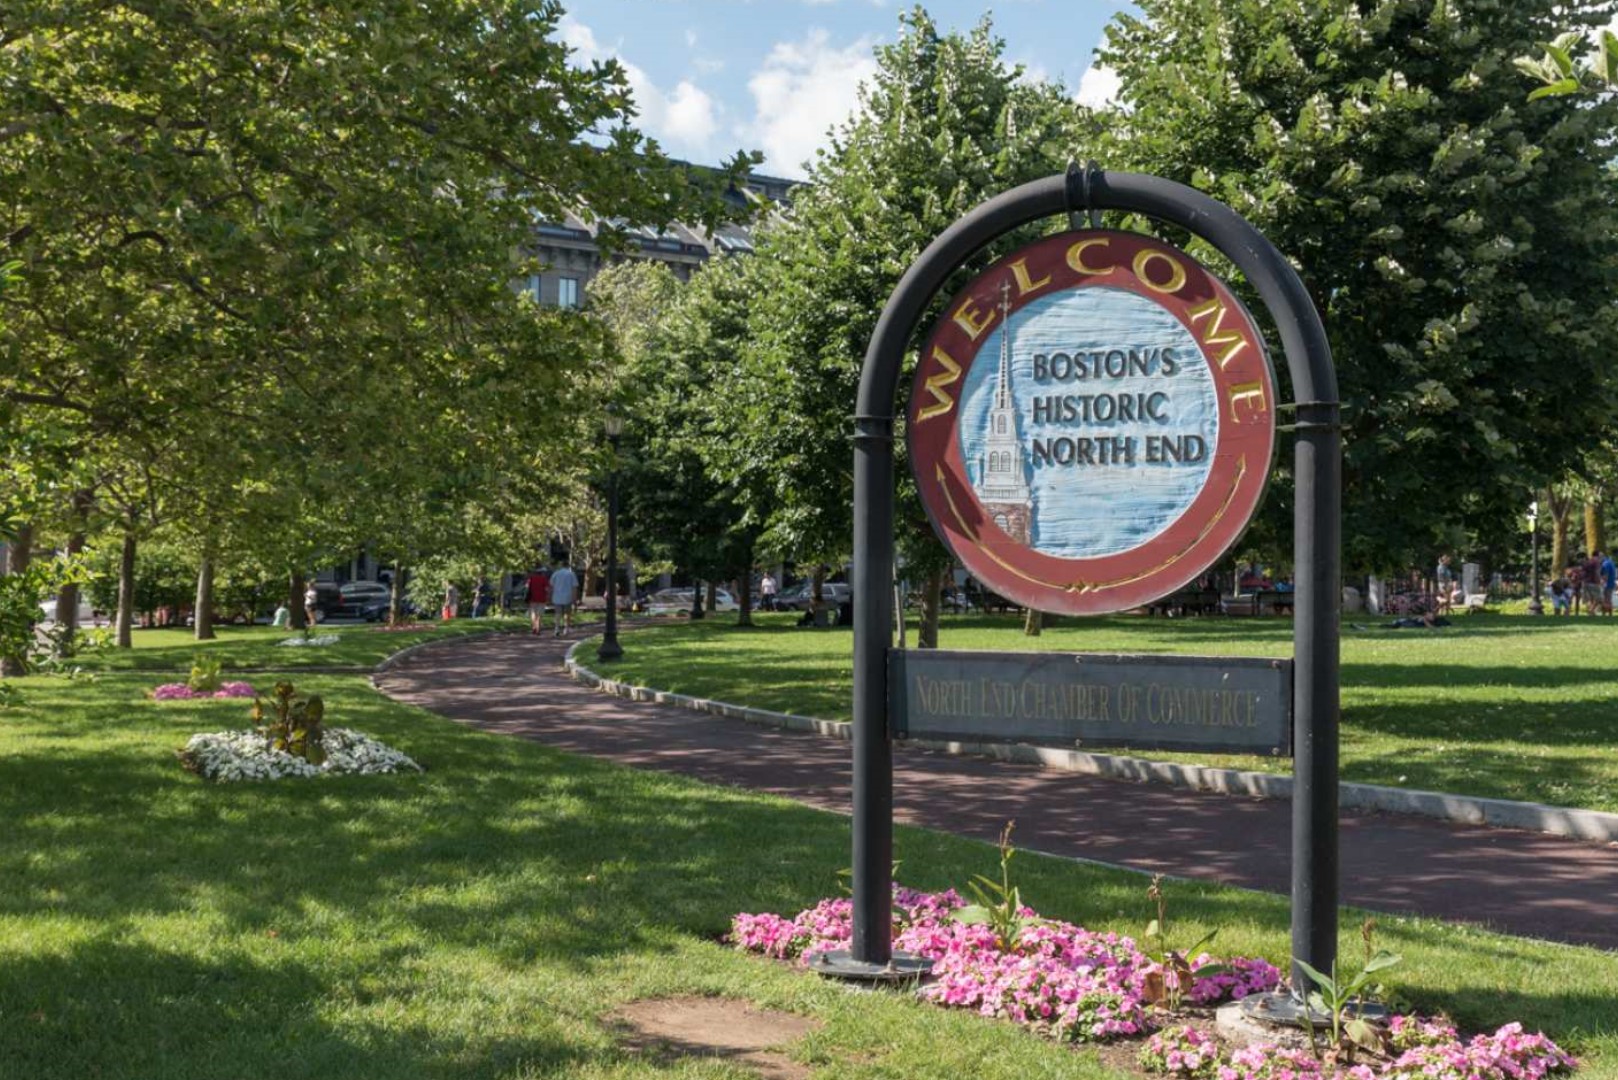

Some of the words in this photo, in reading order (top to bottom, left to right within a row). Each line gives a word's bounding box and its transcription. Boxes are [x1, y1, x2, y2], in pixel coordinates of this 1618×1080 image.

[917, 237, 1267, 424] WELCOME
[1033, 347, 1177, 381] BOSTON'S
[1032, 392, 1168, 424] HISTORIC
[1032, 436, 1132, 466] NORTH
[1146, 435, 1205, 463] END
[915, 675, 972, 716] NORTH
[980, 677, 1016, 718] END
[1019, 678, 1110, 721] CHAMBER
[1117, 682, 1141, 723] OF
[1146, 682, 1258, 727] COMMERCE
